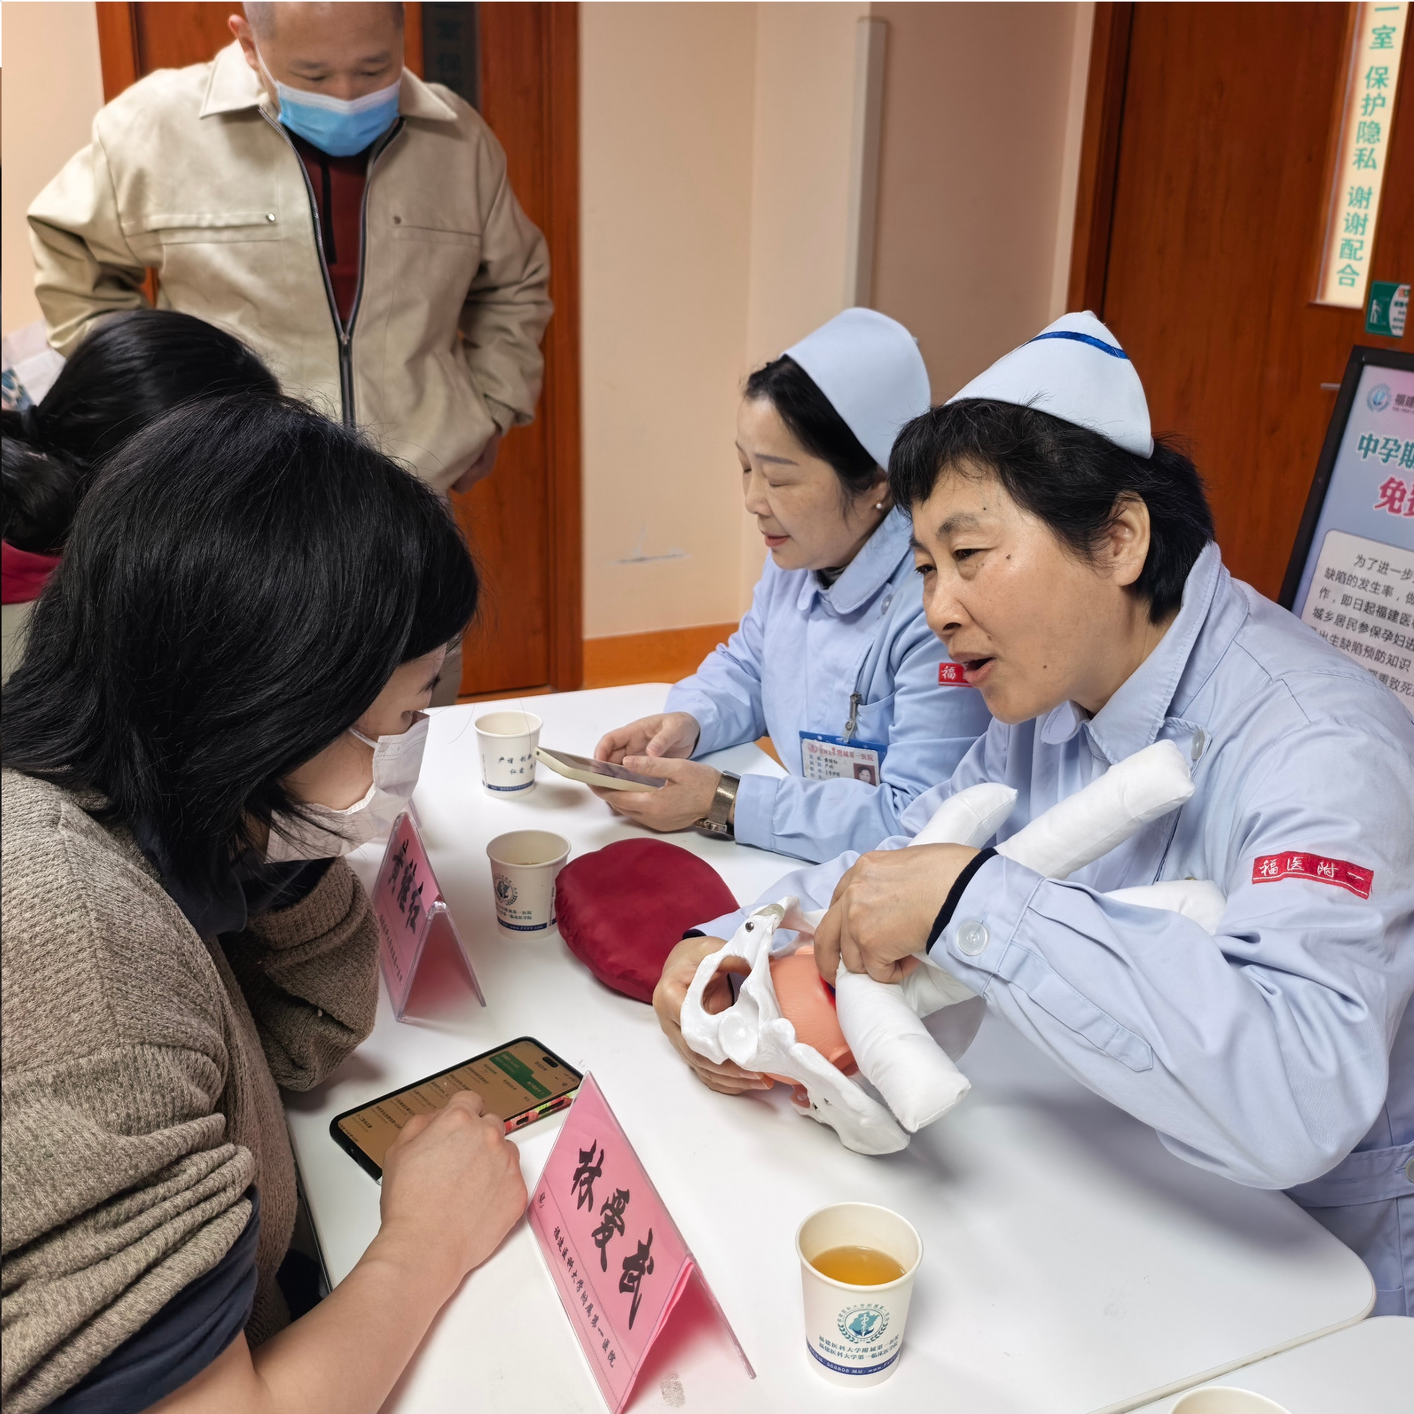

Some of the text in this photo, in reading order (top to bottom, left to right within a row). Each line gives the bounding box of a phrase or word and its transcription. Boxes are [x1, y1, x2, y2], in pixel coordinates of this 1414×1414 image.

[1336, 6, 1400, 288] 一室 保护隐私 谢谢配合
[1258, 855, 1366, 882] 福医附一
[552, 1224, 616, 1369] 福建医科大学附属第一医院
